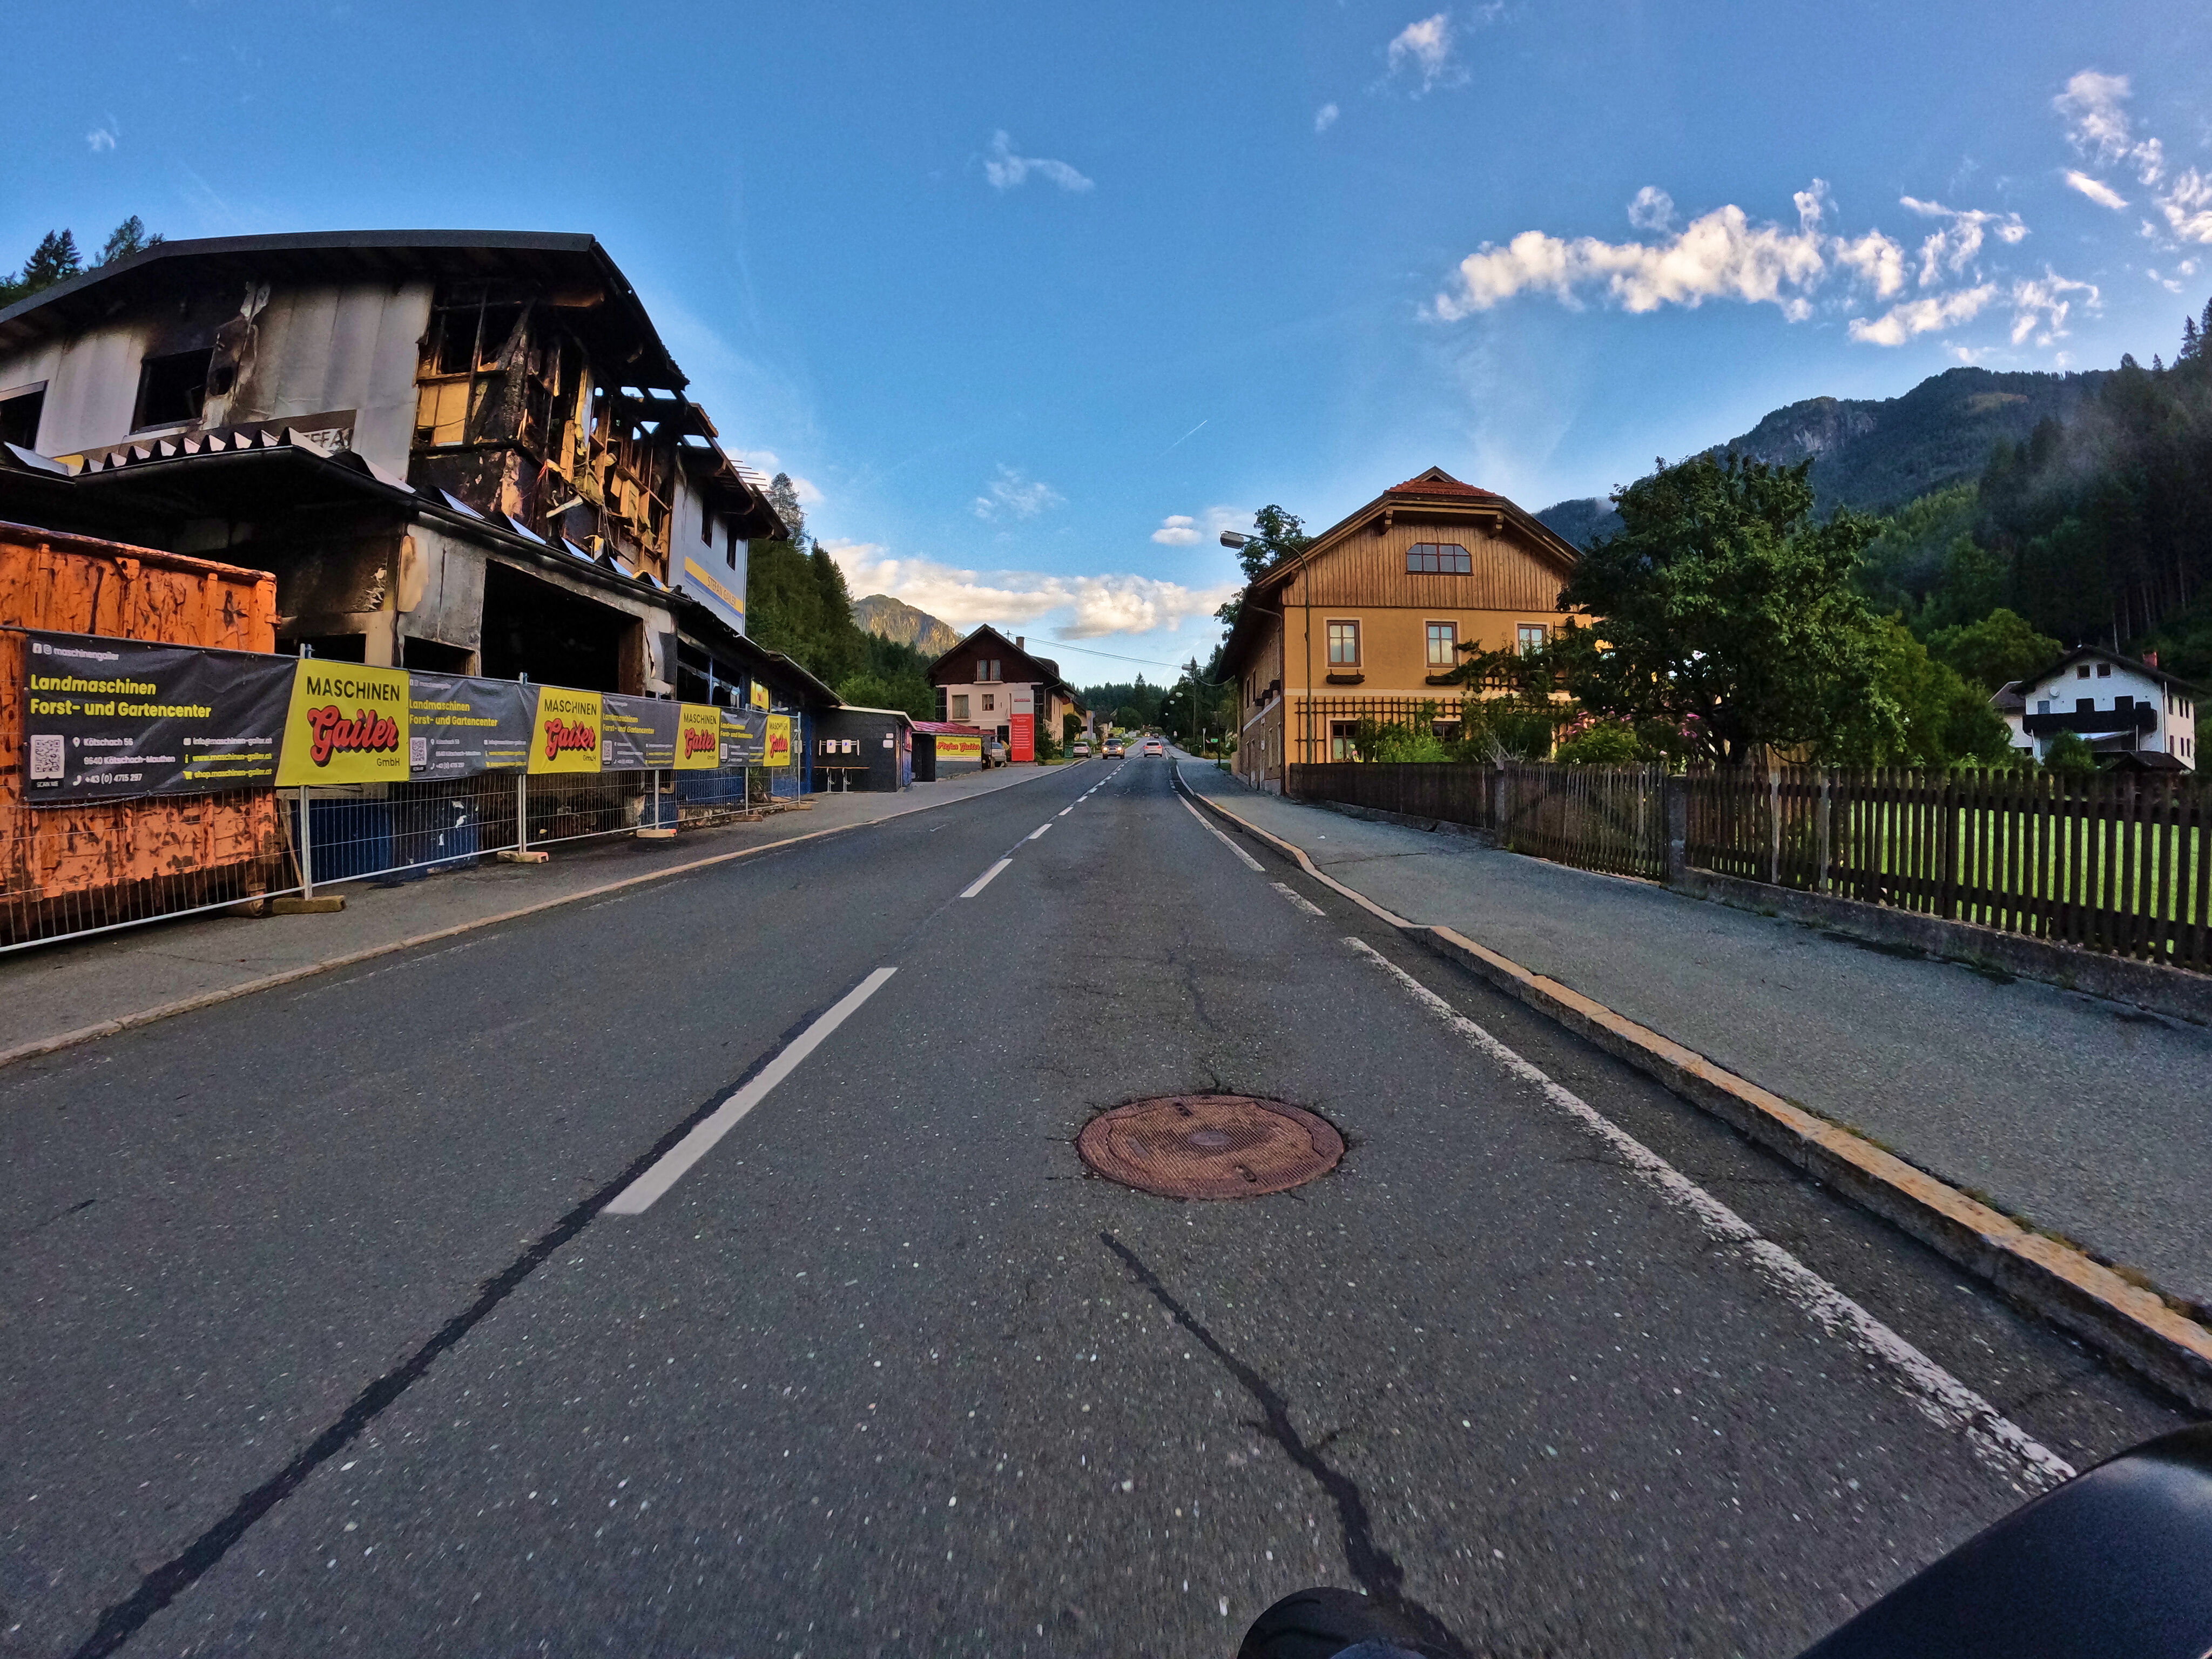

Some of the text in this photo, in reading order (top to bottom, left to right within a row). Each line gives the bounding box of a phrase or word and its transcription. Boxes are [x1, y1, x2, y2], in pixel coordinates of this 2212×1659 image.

[31, 674, 157, 696] Landmaschinen
[307, 676, 400, 702] MASCHINEN
[31, 699, 211, 718] Forst- und Gartencenter
[409, 699, 470, 711] Landmaschinen
[544, 699, 597, 715] MASCHINEN
[409, 714, 498, 727] Forst- und Gartencenter
[683, 713, 717, 725] MASCHINEN
[84, 738, 123, 746] Kötschach
[307, 705, 399, 767] Gailer
[544, 718, 596, 761] Gailer
[684, 727, 716, 760] Gailer
[376, 757, 400, 766] GmbH
[85, 775, 99, 783] +43
[101, 773, 112, 784] (0)
